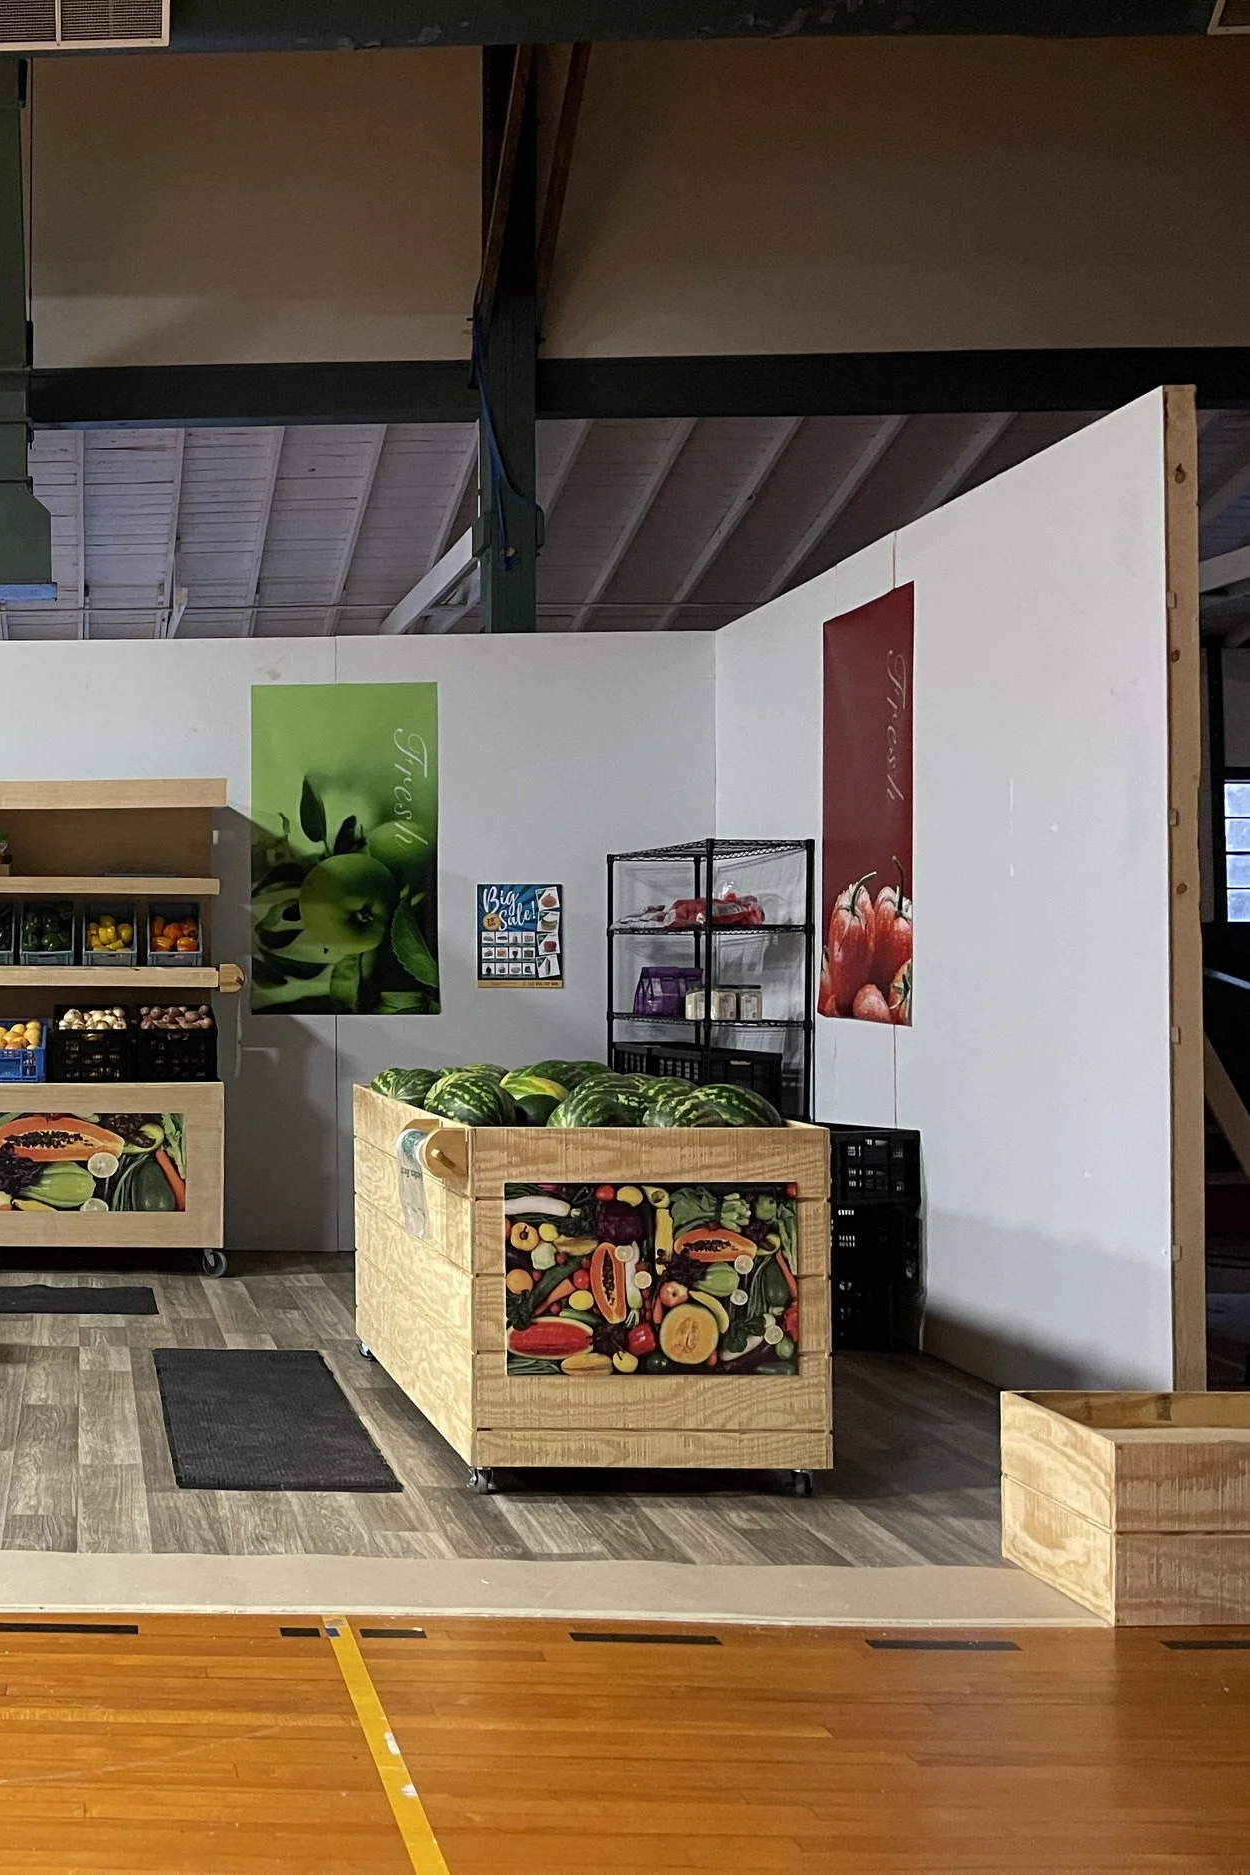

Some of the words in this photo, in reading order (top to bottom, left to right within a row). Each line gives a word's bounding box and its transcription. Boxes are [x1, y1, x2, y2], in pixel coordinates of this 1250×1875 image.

[886, 649, 907, 801] Fresh
[393, 728, 429, 850] Fresh
[483, 886, 519, 914] Big
[498, 901, 537, 932] Sale!
